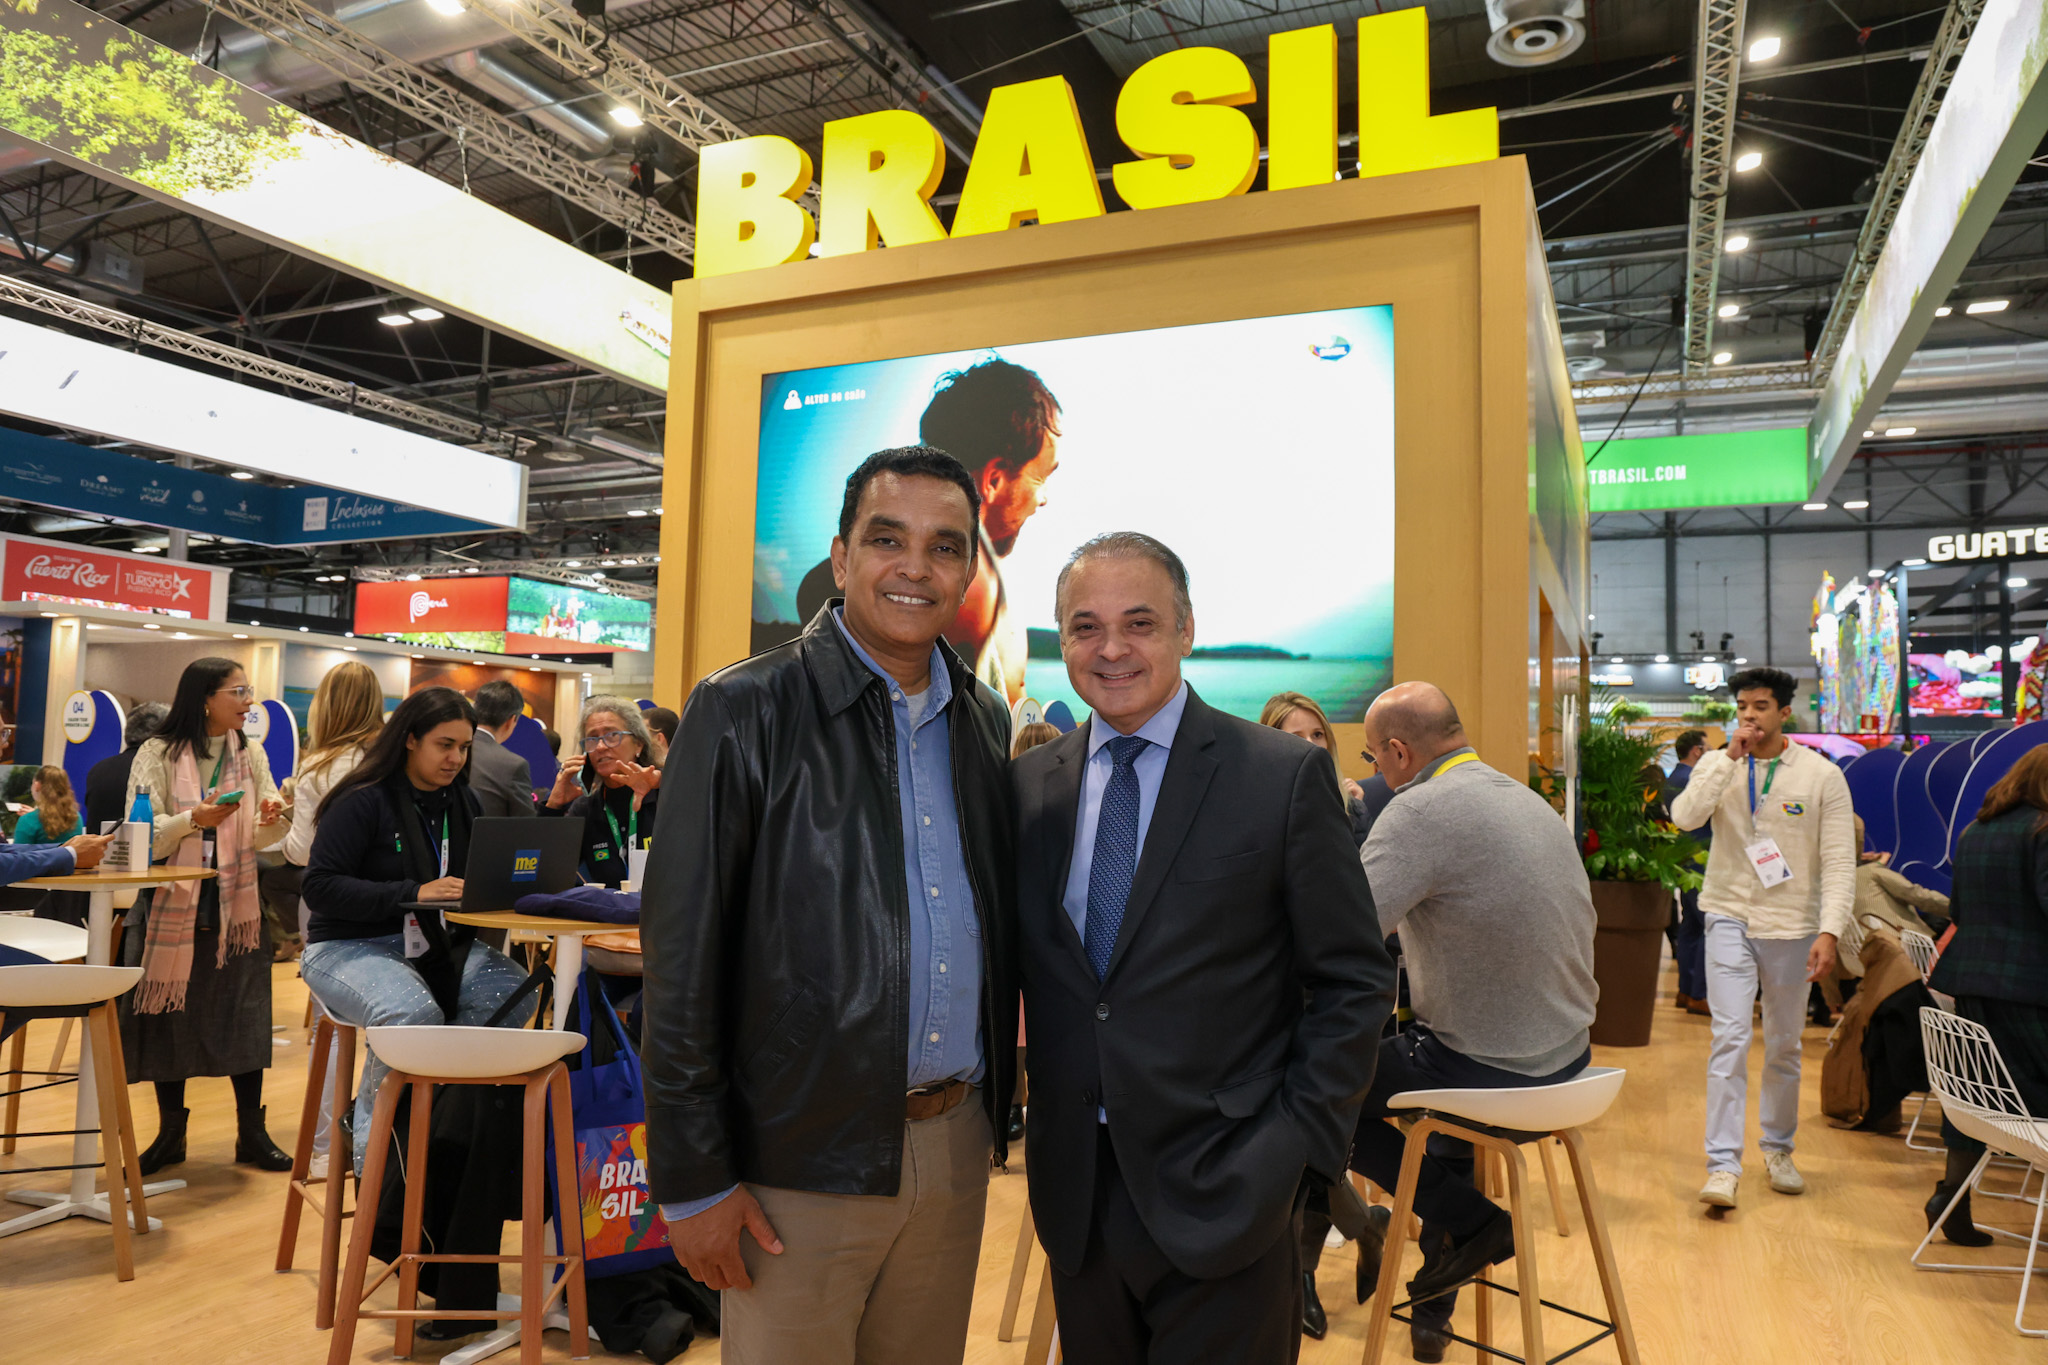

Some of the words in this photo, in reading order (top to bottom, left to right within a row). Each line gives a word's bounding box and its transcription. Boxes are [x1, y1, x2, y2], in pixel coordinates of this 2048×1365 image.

[694, 6, 1499, 280] BRASIL
[1589, 465, 1687, 485] TBRASIL.COM
[330, 496, 385, 522] Inclusive
[331, 520, 382, 529] COLLECTION
[1928, 526, 2048, 562] GUATE
[24, 555, 75, 580] Puerto
[72, 563, 111, 588] Rico
[124, 572, 173, 590] TURISMO
[73, 701, 84, 714] 04
[247, 712, 259, 724] 05
[514, 857, 538, 870] me
[599, 1159, 647, 1190] BRA
[600, 1190, 645, 1220] SIL
